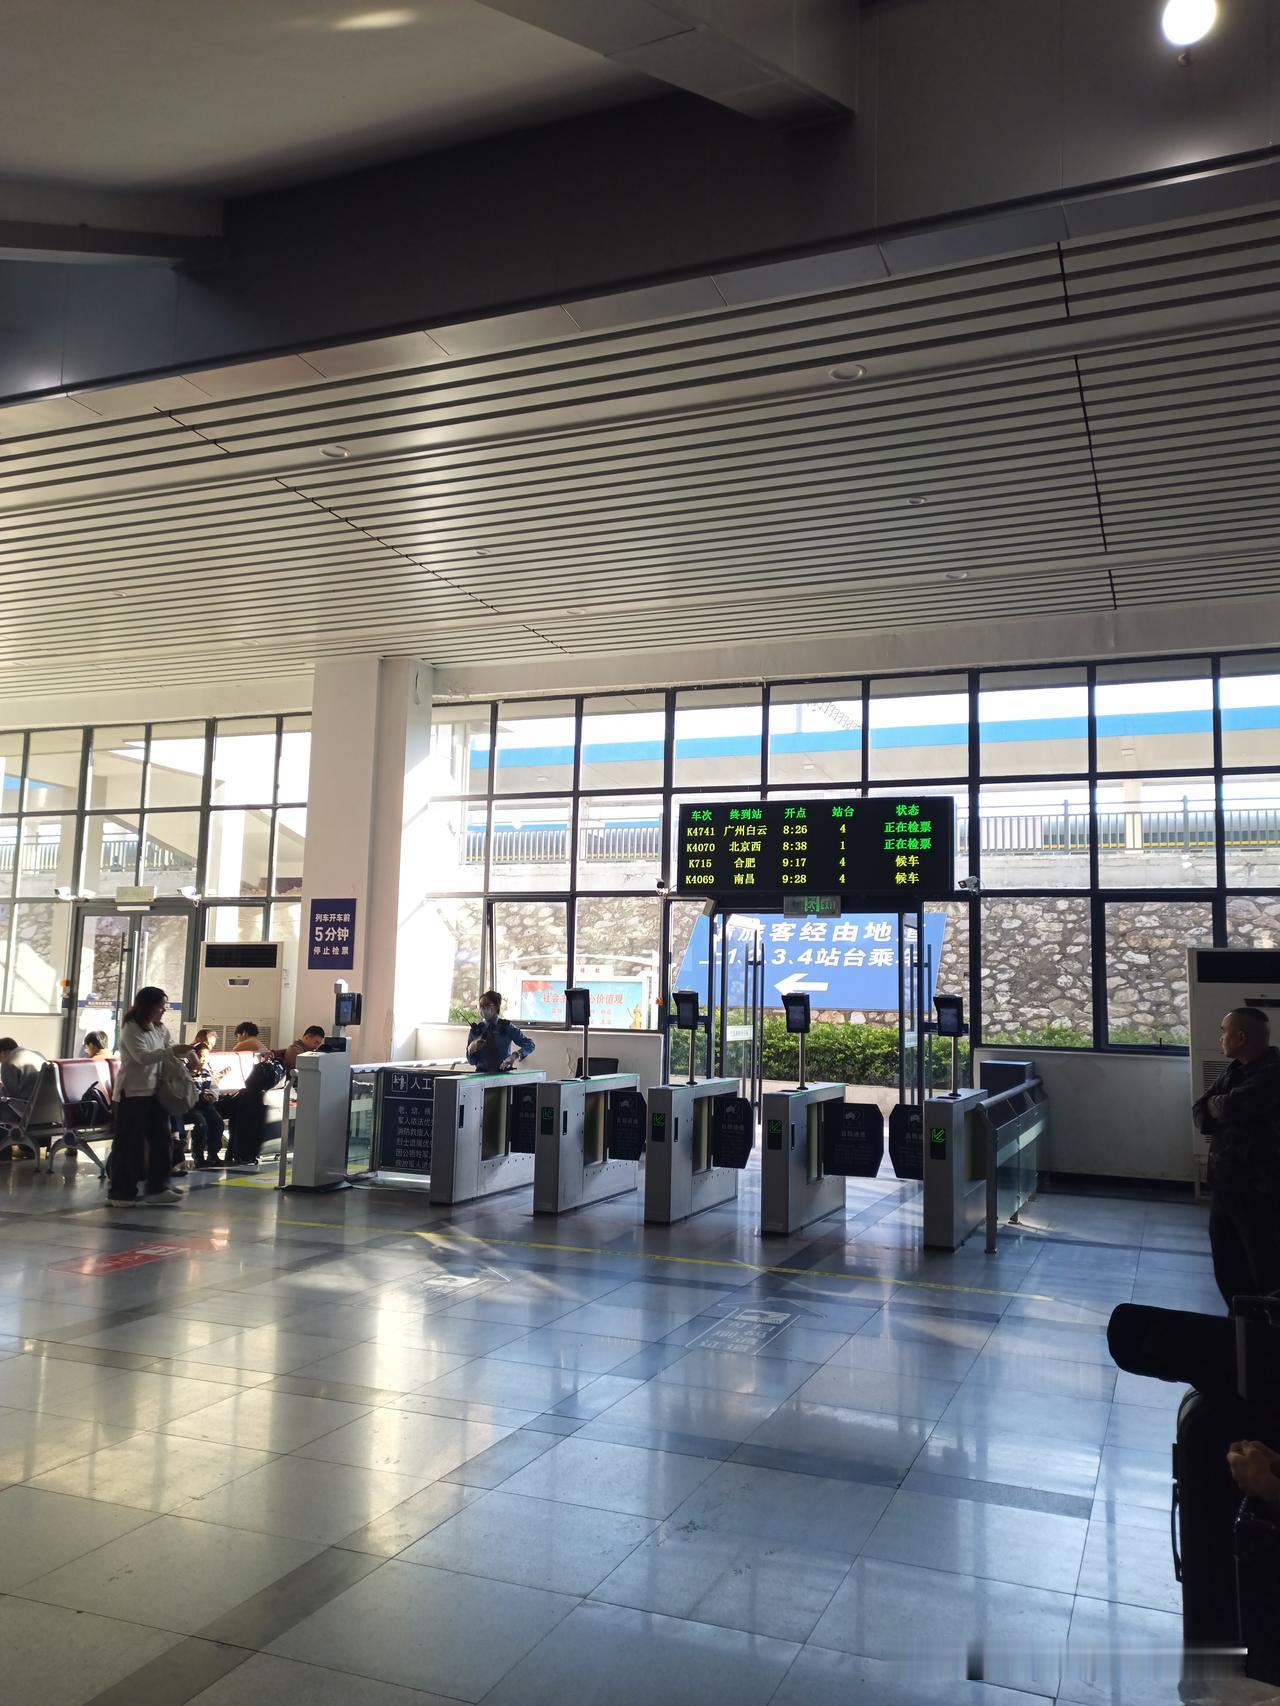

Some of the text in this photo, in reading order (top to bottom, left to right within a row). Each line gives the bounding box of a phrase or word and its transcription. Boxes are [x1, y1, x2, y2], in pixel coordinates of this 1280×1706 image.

[690, 804, 920, 822] 车次 终到站 开点 站台 状态
[686, 820, 933, 837] K4741 广州白云 8:26 4 正在检票
[686, 837, 932, 853] K4070 北京西 8:38 1 正在检票
[688, 854, 920, 869] K715 合肥 9:17 4 候车
[685, 871, 920, 885] K4069 南昌 9:28 4 候车
[315, 913, 351, 922] 列车开车前
[314, 926, 350, 942] 5分钟
[313, 946, 349, 956] 停止检票
[397, 1128, 433, 1137] 消防救援人
